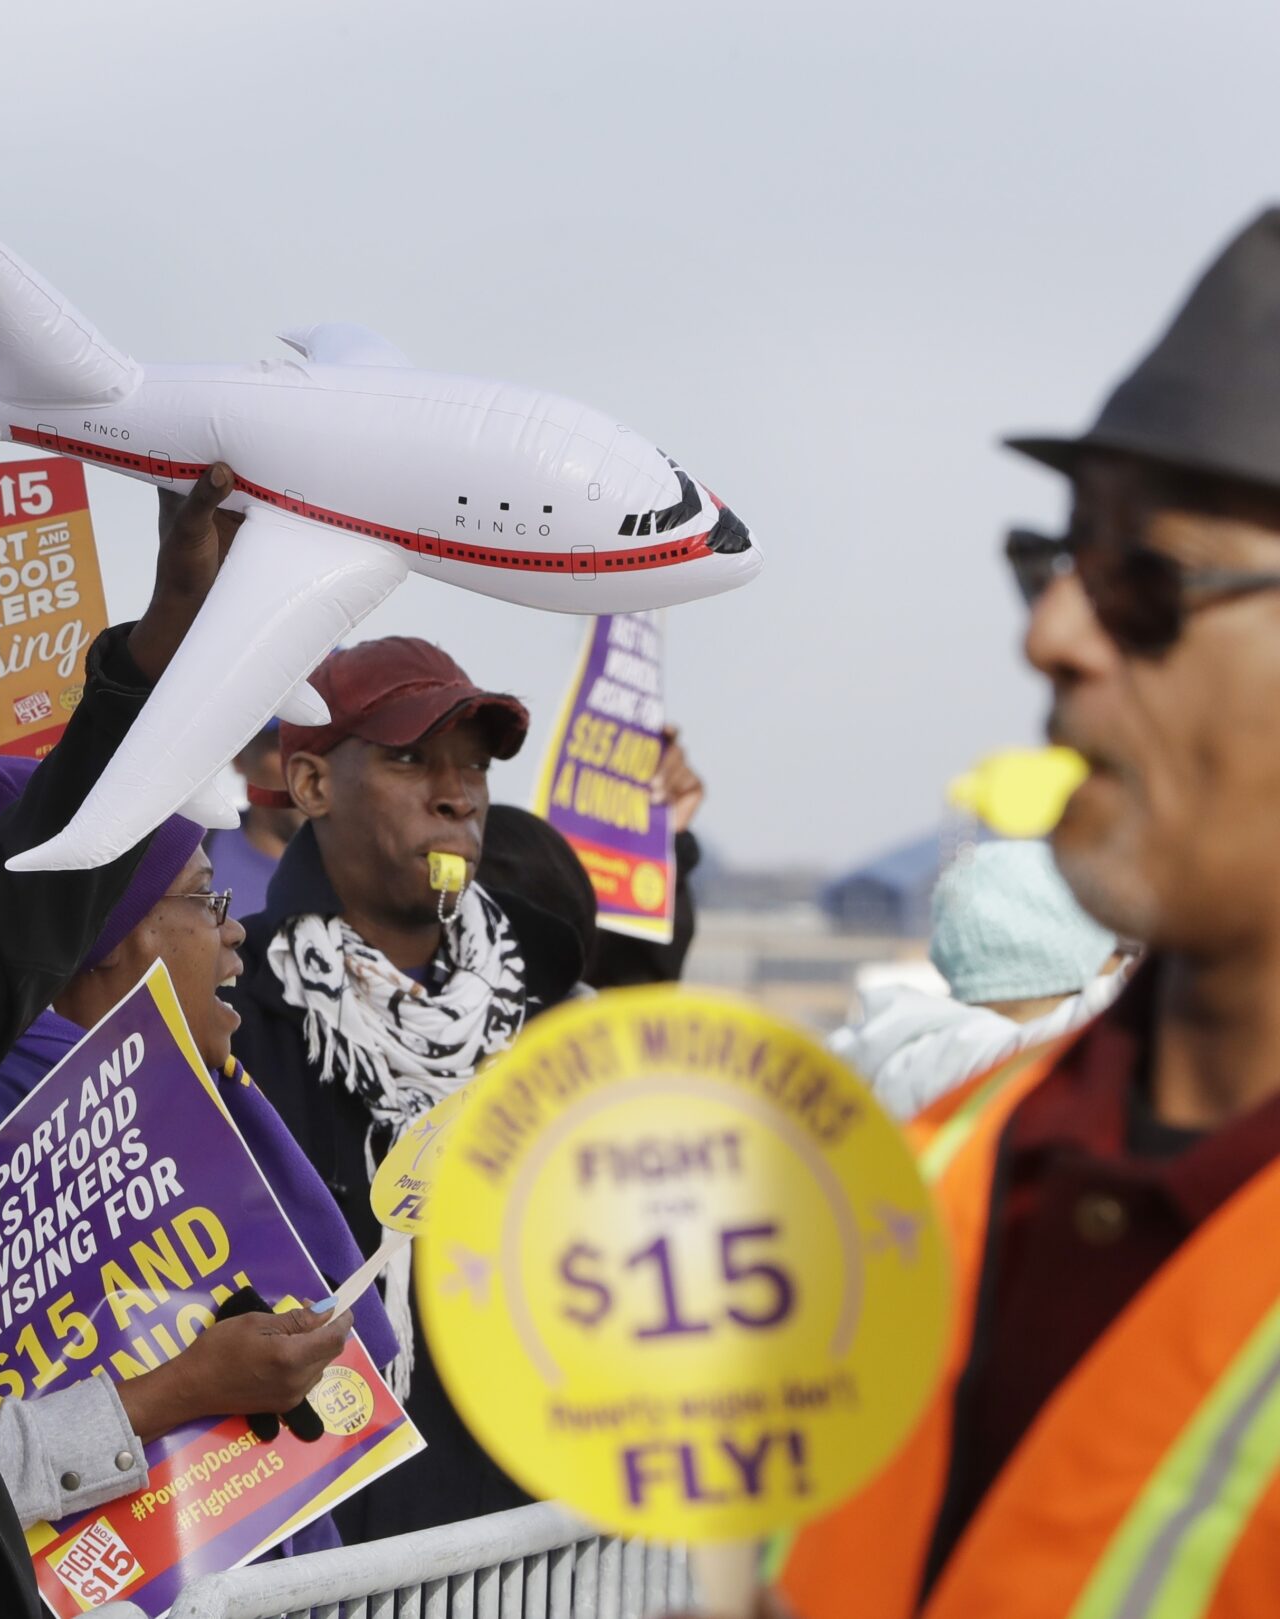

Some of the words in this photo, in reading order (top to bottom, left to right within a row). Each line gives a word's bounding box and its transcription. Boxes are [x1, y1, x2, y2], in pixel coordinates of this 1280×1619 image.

[83, 420, 131, 441] RINCO
[37, 529, 70, 548] AND
[455, 515, 551, 537] RINCO
[77, 1032, 145, 1122] AND
[50, 1086, 138, 1192] FOOD
[576, 1129, 746, 1188] FIGHT
[105, 1157, 185, 1241] FOR
[389, 1193, 430, 1222] FL
[394, 1174, 431, 1194] Pover
[100, 1205, 231, 1330] AND
[557, 1221, 799, 1342] $15
[90, 1270, 253, 1382] NIO
[325, 1390, 357, 1415] $15
[344, 1413, 367, 1433] FLY!
[131, 1431, 261, 1522] #PovertyDoesn
[177, 1450, 285, 1532] #FightFor15
[620, 1431, 812, 1509] FLY!
[56, 1523, 107, 1585] FIGHT
[93, 1525, 113, 1542] FOR
[81, 1543, 135, 1605] $15
